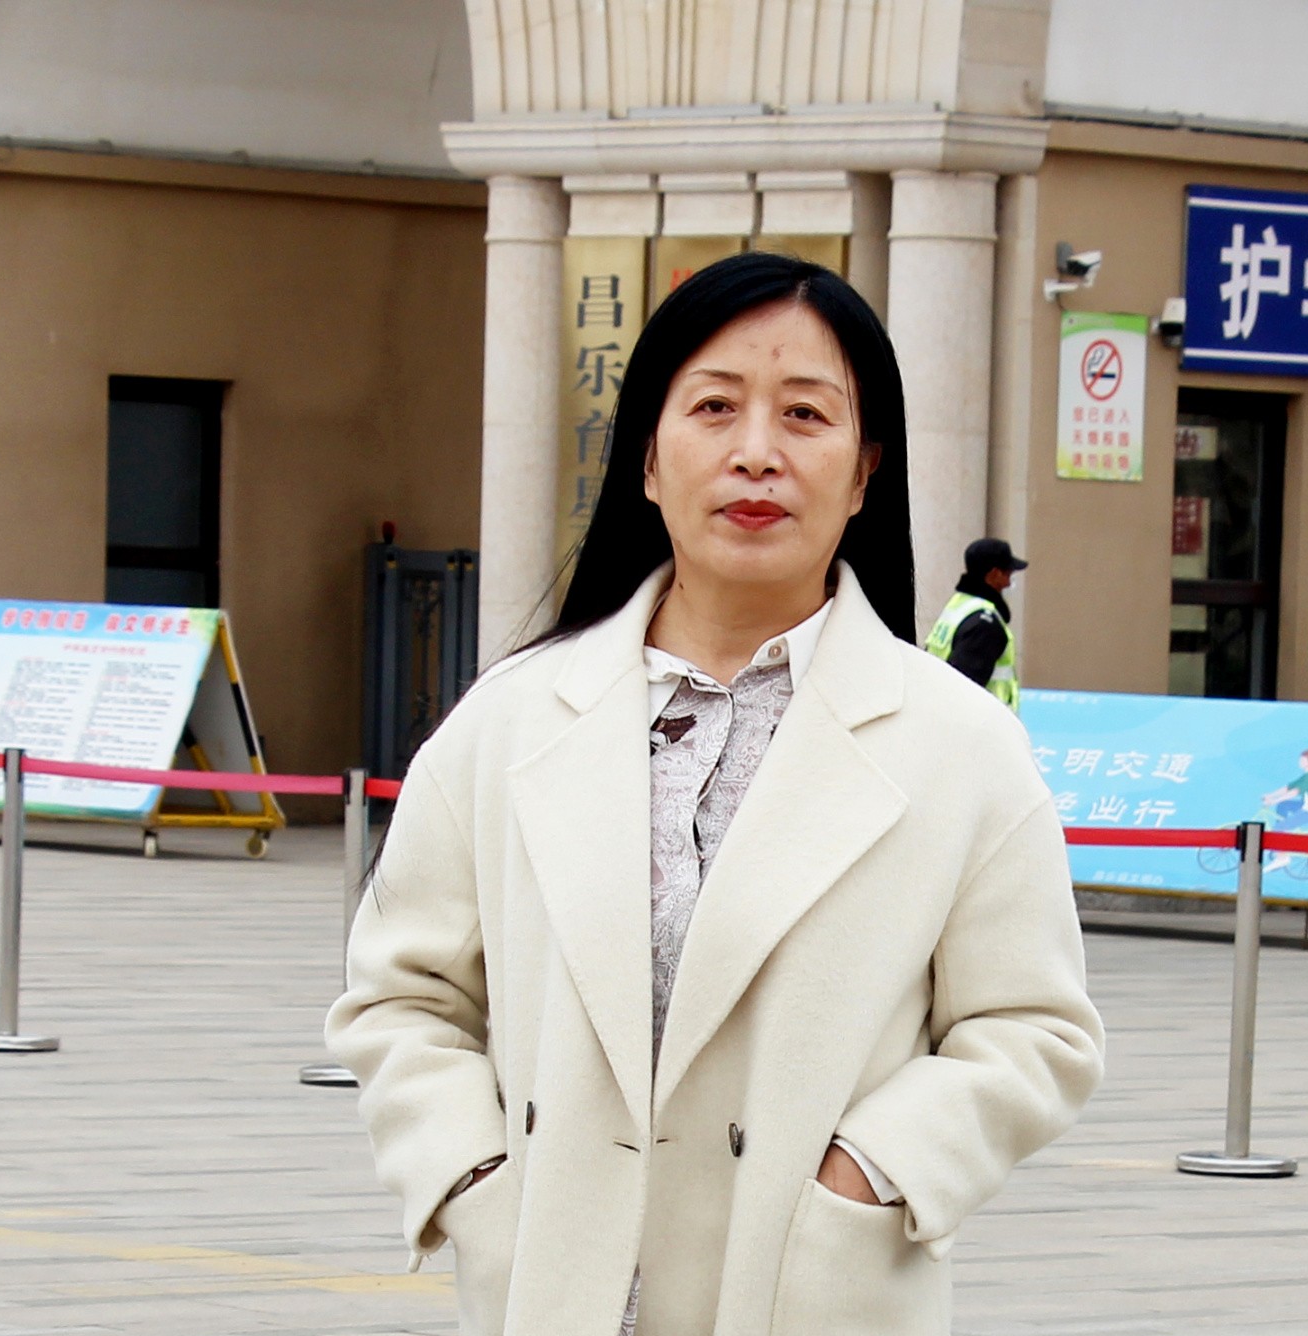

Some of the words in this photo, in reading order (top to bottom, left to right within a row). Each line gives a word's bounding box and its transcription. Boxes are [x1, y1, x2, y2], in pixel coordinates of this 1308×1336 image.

[1032, 746, 1194, 784] 文明交通
[1053, 791, 1177, 828] 色出行
